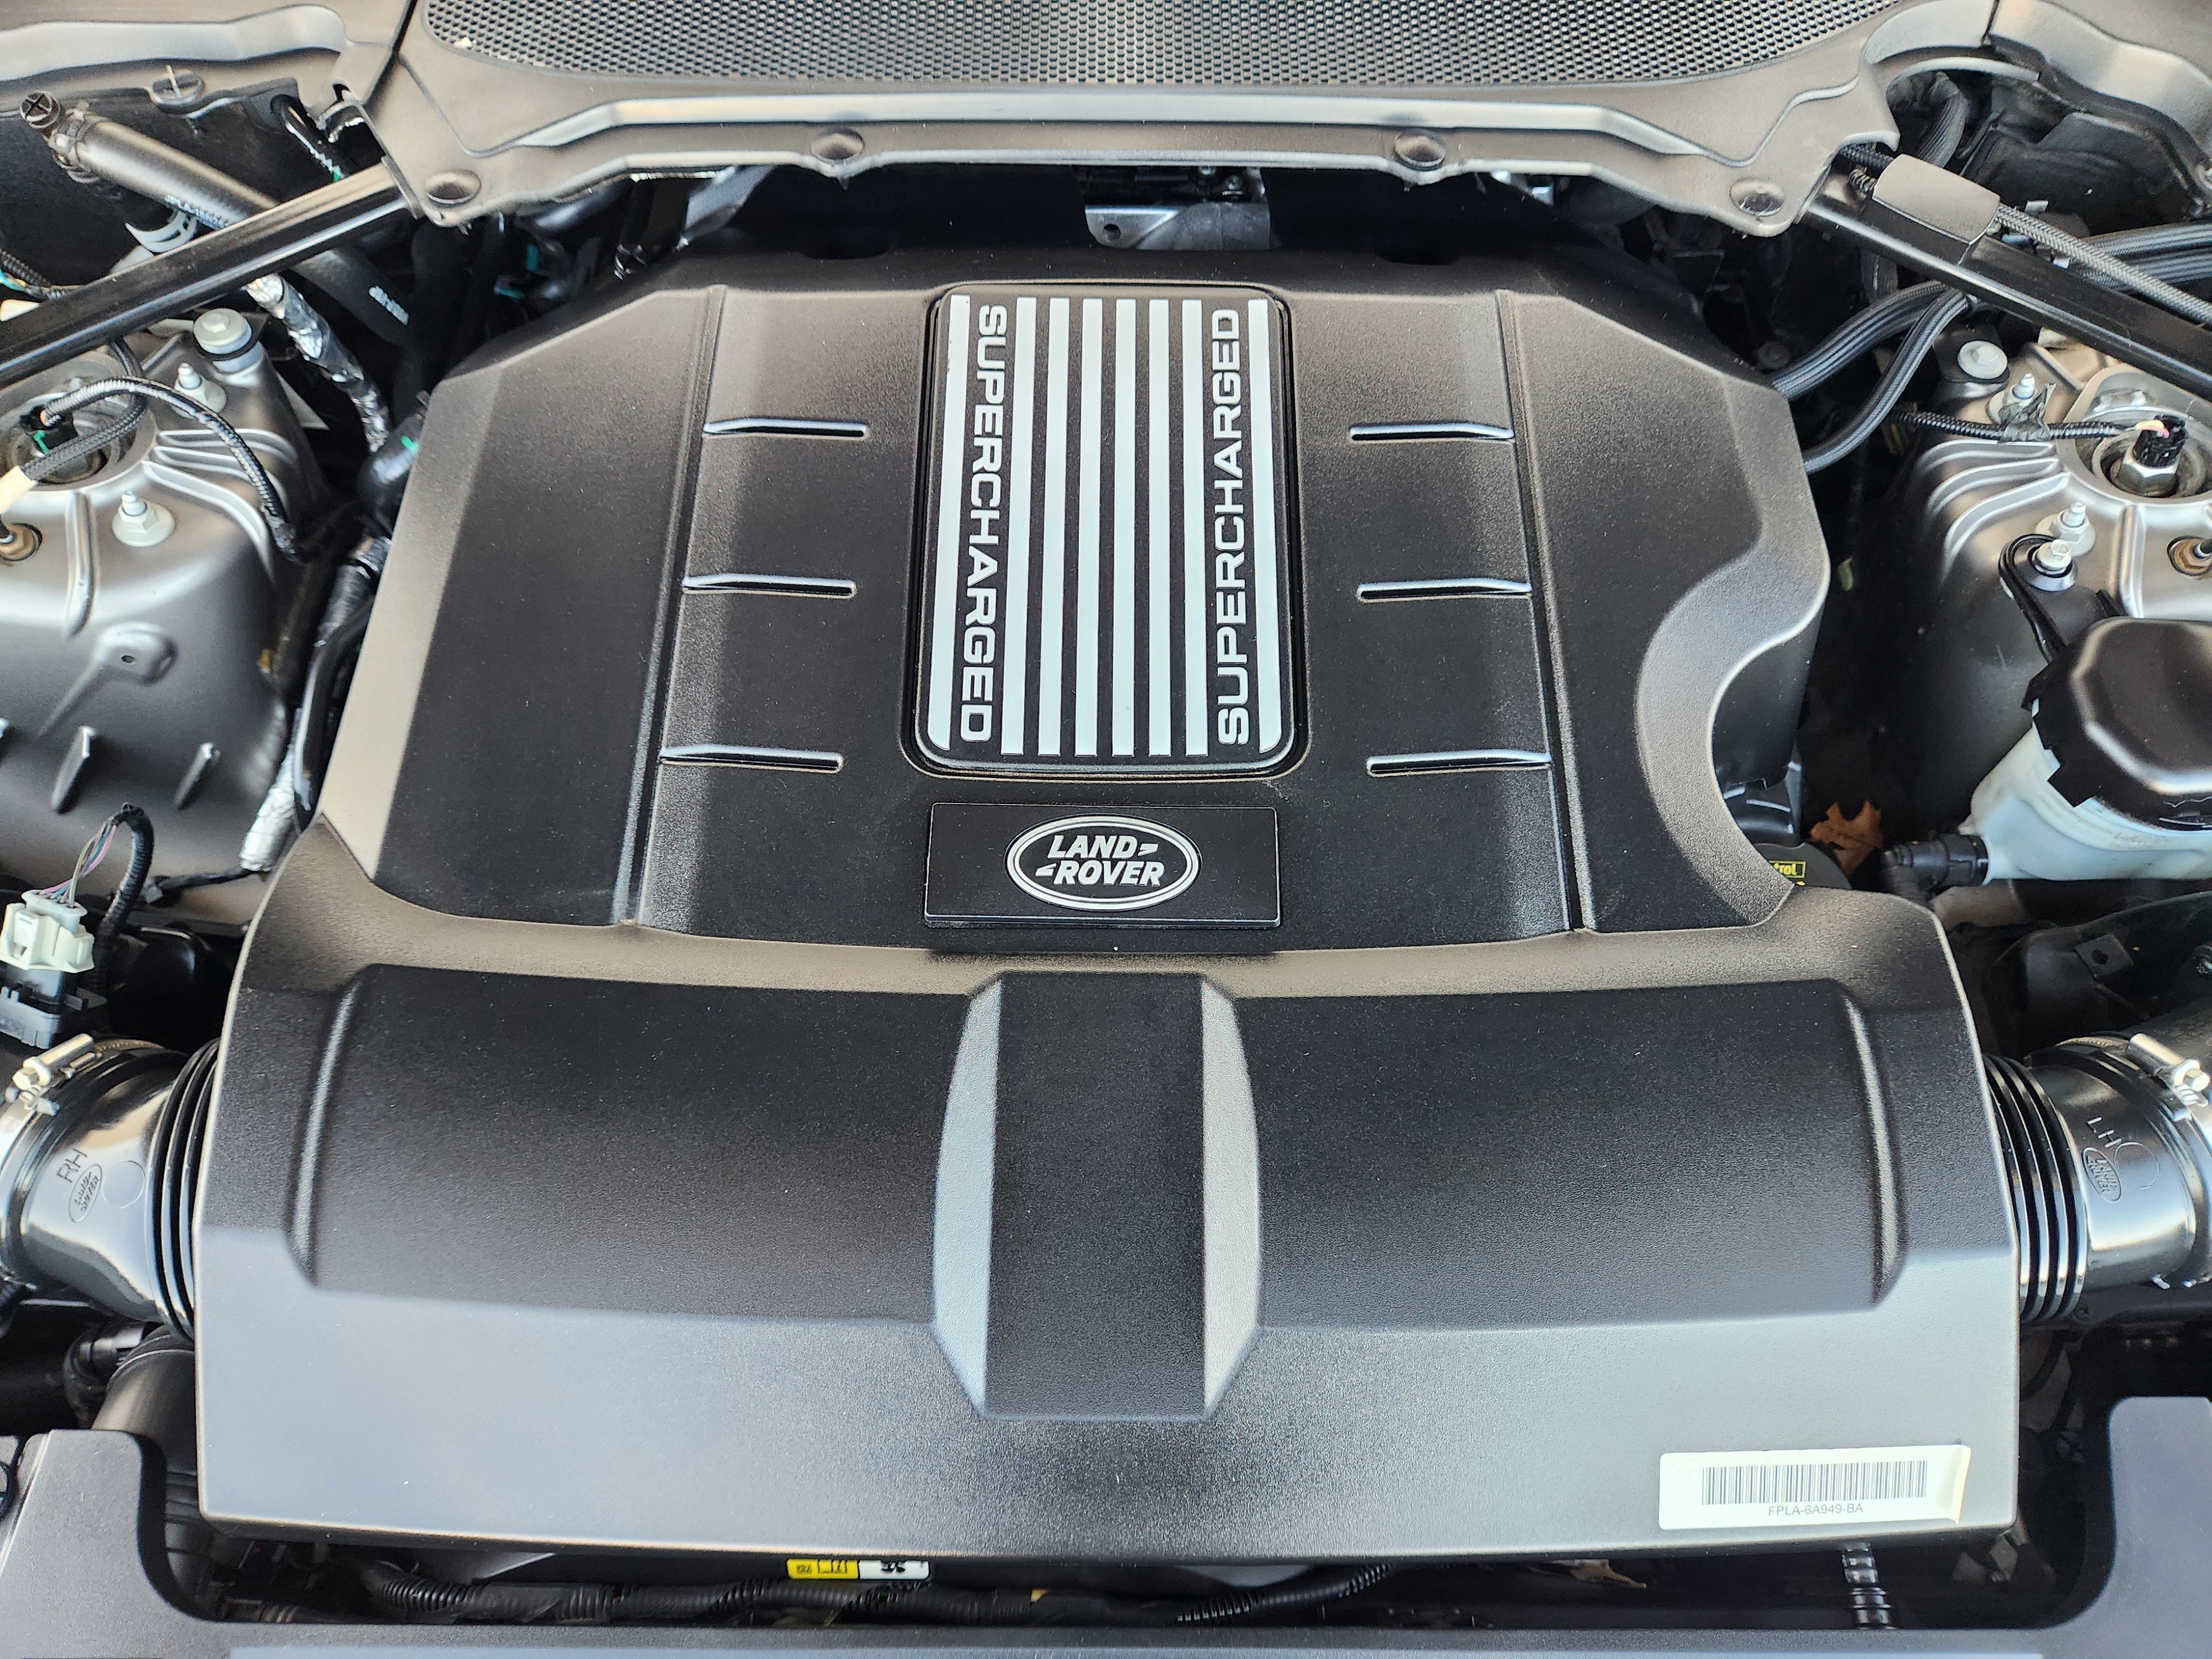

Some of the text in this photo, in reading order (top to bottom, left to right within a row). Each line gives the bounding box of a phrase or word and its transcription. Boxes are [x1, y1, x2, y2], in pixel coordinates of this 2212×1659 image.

[960, 304, 1008, 743] SUPERCHARGED
[1212, 309, 1250, 745] SUPERCHARGED
[1047, 834, 1139, 859] LAND
[1053, 860, 1165, 886] ROVER
[2086, 1117, 2122, 1148] LH
[56, 1148, 88, 1183] RH
[1768, 1503, 1864, 1516] FPLA-6A949-BA
